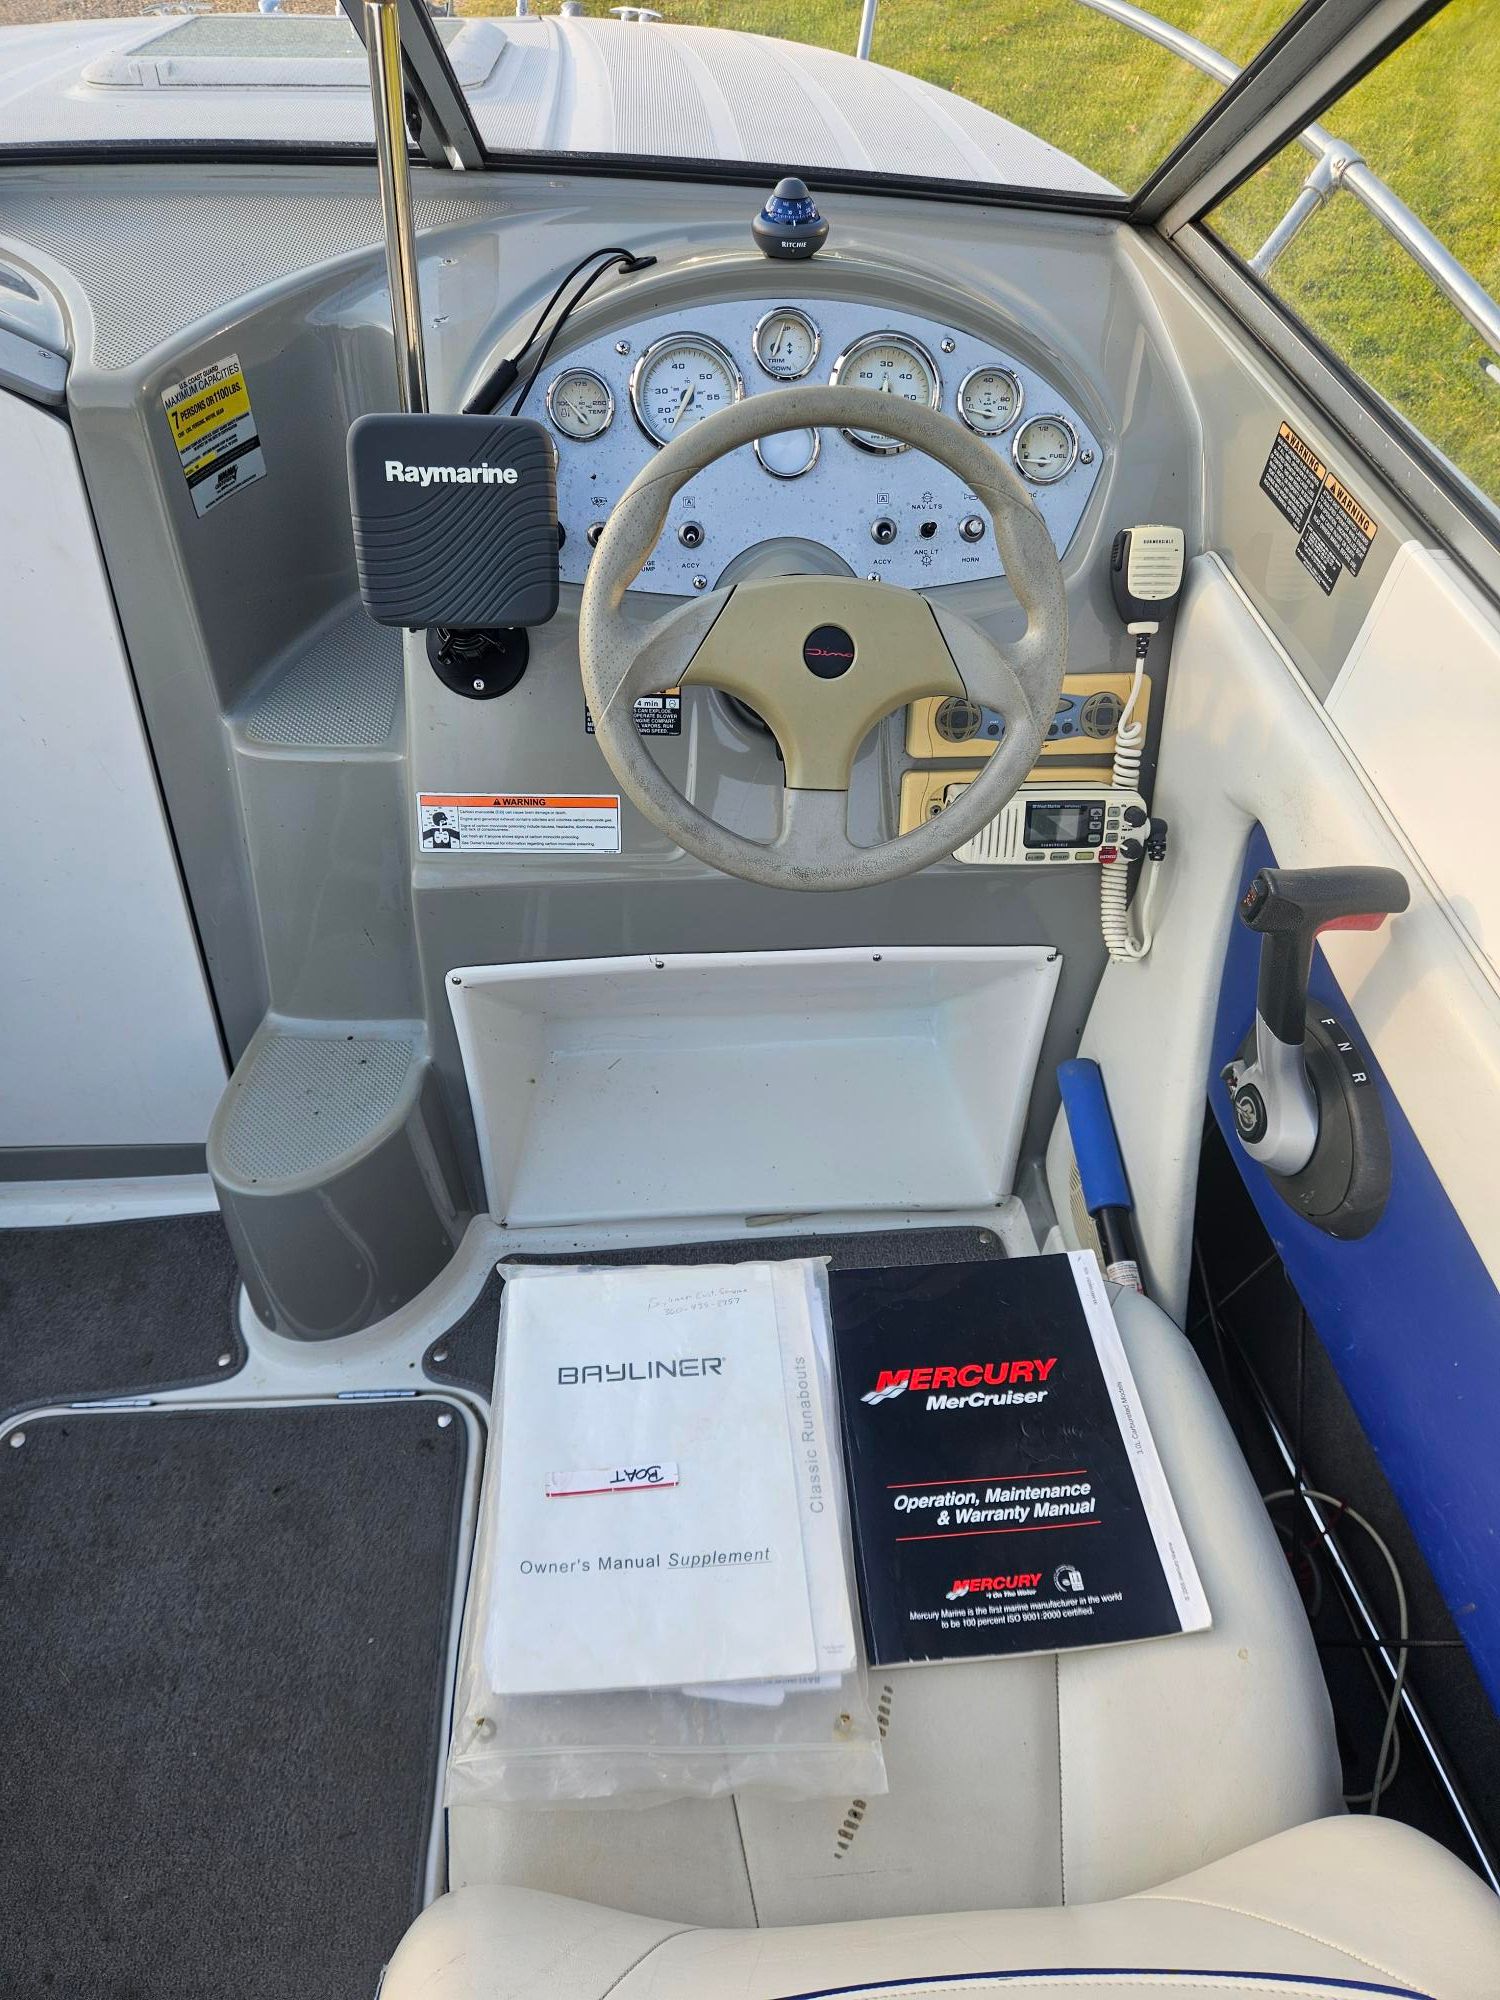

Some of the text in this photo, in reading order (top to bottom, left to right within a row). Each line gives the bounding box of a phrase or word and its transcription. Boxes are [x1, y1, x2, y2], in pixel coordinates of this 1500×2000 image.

[188, 372, 202, 387] COAST
[203, 365, 219, 378] GUARD
[880, 360, 894, 368] 30
[164, 362, 240, 410] MAXIMUM CAPACITIES
[171, 382, 242, 430] 7 PERSONS OR 1100 LBS.
[1289, 429, 1319, 472] WARNING
[384, 460, 518, 487] Raymarine
[1335, 488, 1370, 531] WARNING
[502, 798, 546, 806] WARNING
[1337, 1042, 1353, 1052] N
[1352, 1072, 1367, 1083] R
[558, 1357, 722, 1385] BAYLINER
[875, 1357, 1058, 1392] MERCURY
[926, 1390, 1049, 1411] MerCruiser
[795, 1356, 824, 1514] Classic Runabouts
[610, 1466, 664, 1484] BOAT
[893, 1482, 1092, 1514] Operation, Maintenance
[936, 1497, 1096, 1526] & Warranty Manual
[520, 1546, 771, 1575] Owner's Manual Supplement
[952, 1572, 1043, 1593] MERCURY
[1017, 1589, 1037, 1597] Water
[909, 1592, 1123, 1621] Mercury Marine is the first marine manufacturer in the world
[941, 1606, 1094, 1629] to be 100 percent ISO 9001:2000 certified.
